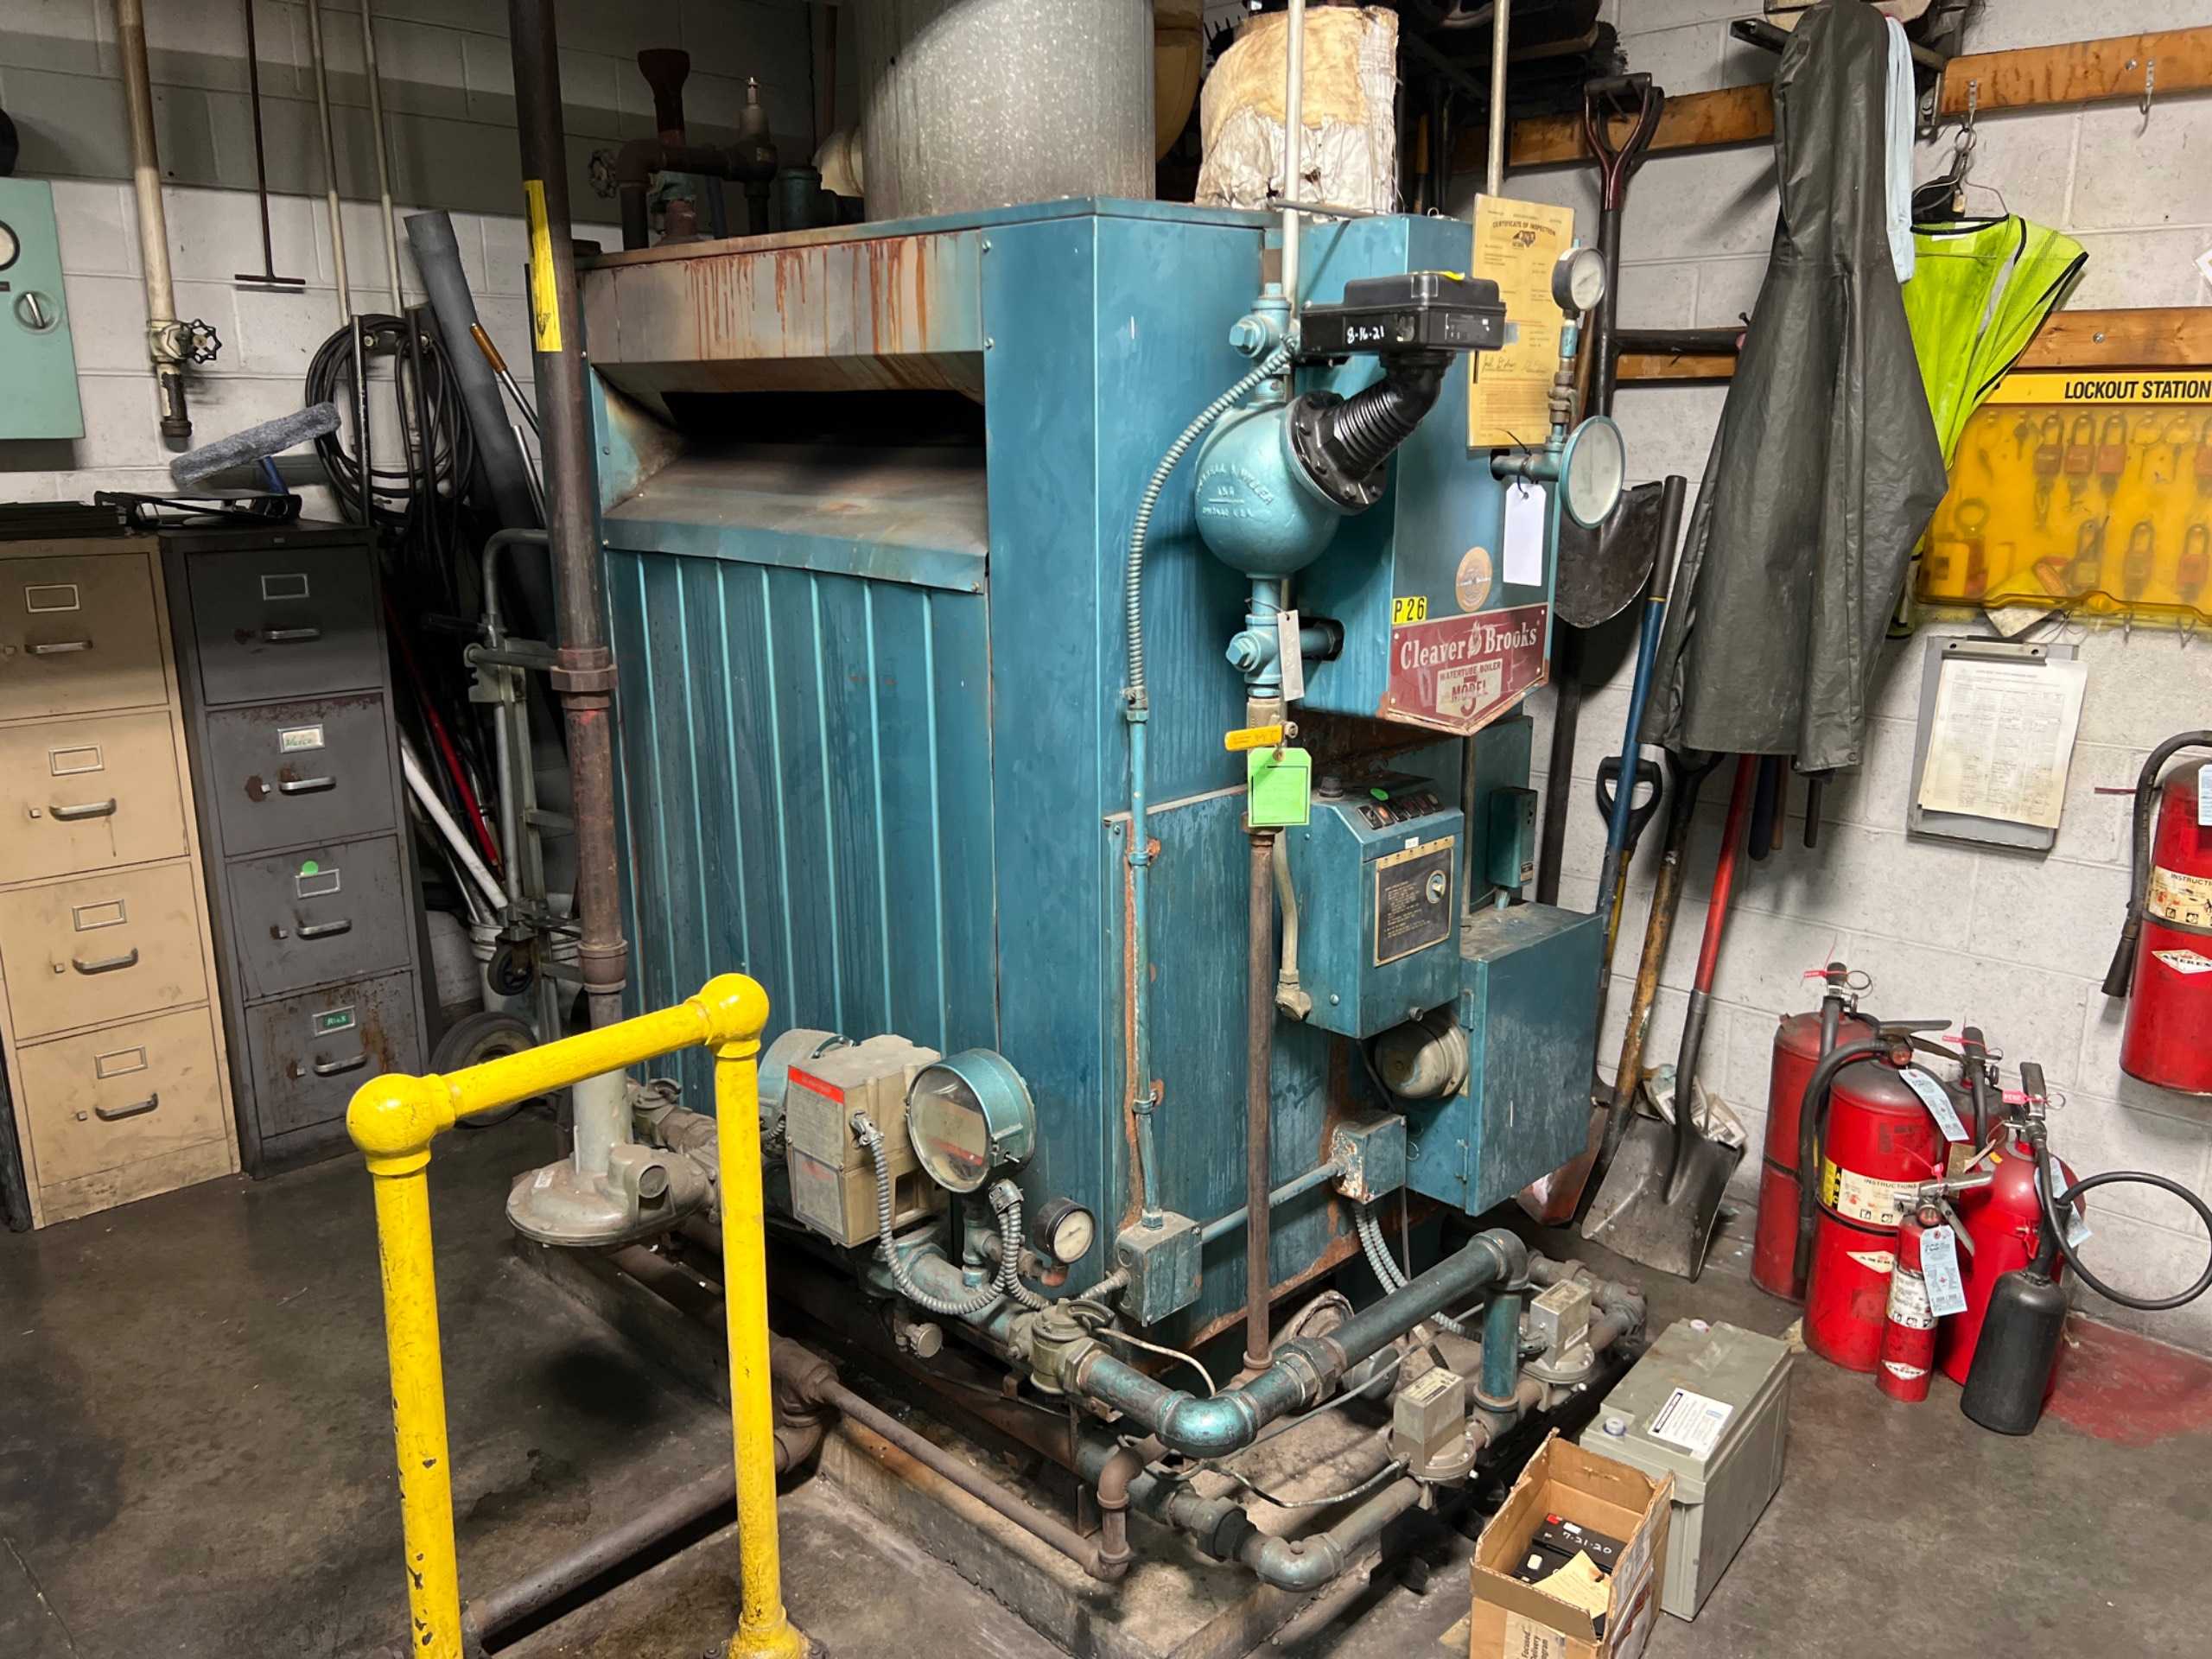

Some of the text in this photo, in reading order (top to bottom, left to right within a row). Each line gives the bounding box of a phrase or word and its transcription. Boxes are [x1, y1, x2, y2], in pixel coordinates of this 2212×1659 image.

[1529, 223, 1556, 237] INSPECTION
[2064, 380, 2212, 399] LOCKOUT STATION
[1400, 621, 1538, 671] Cleaver Brooks
[2171, 873, 2212, 887] INSTRUCTI
